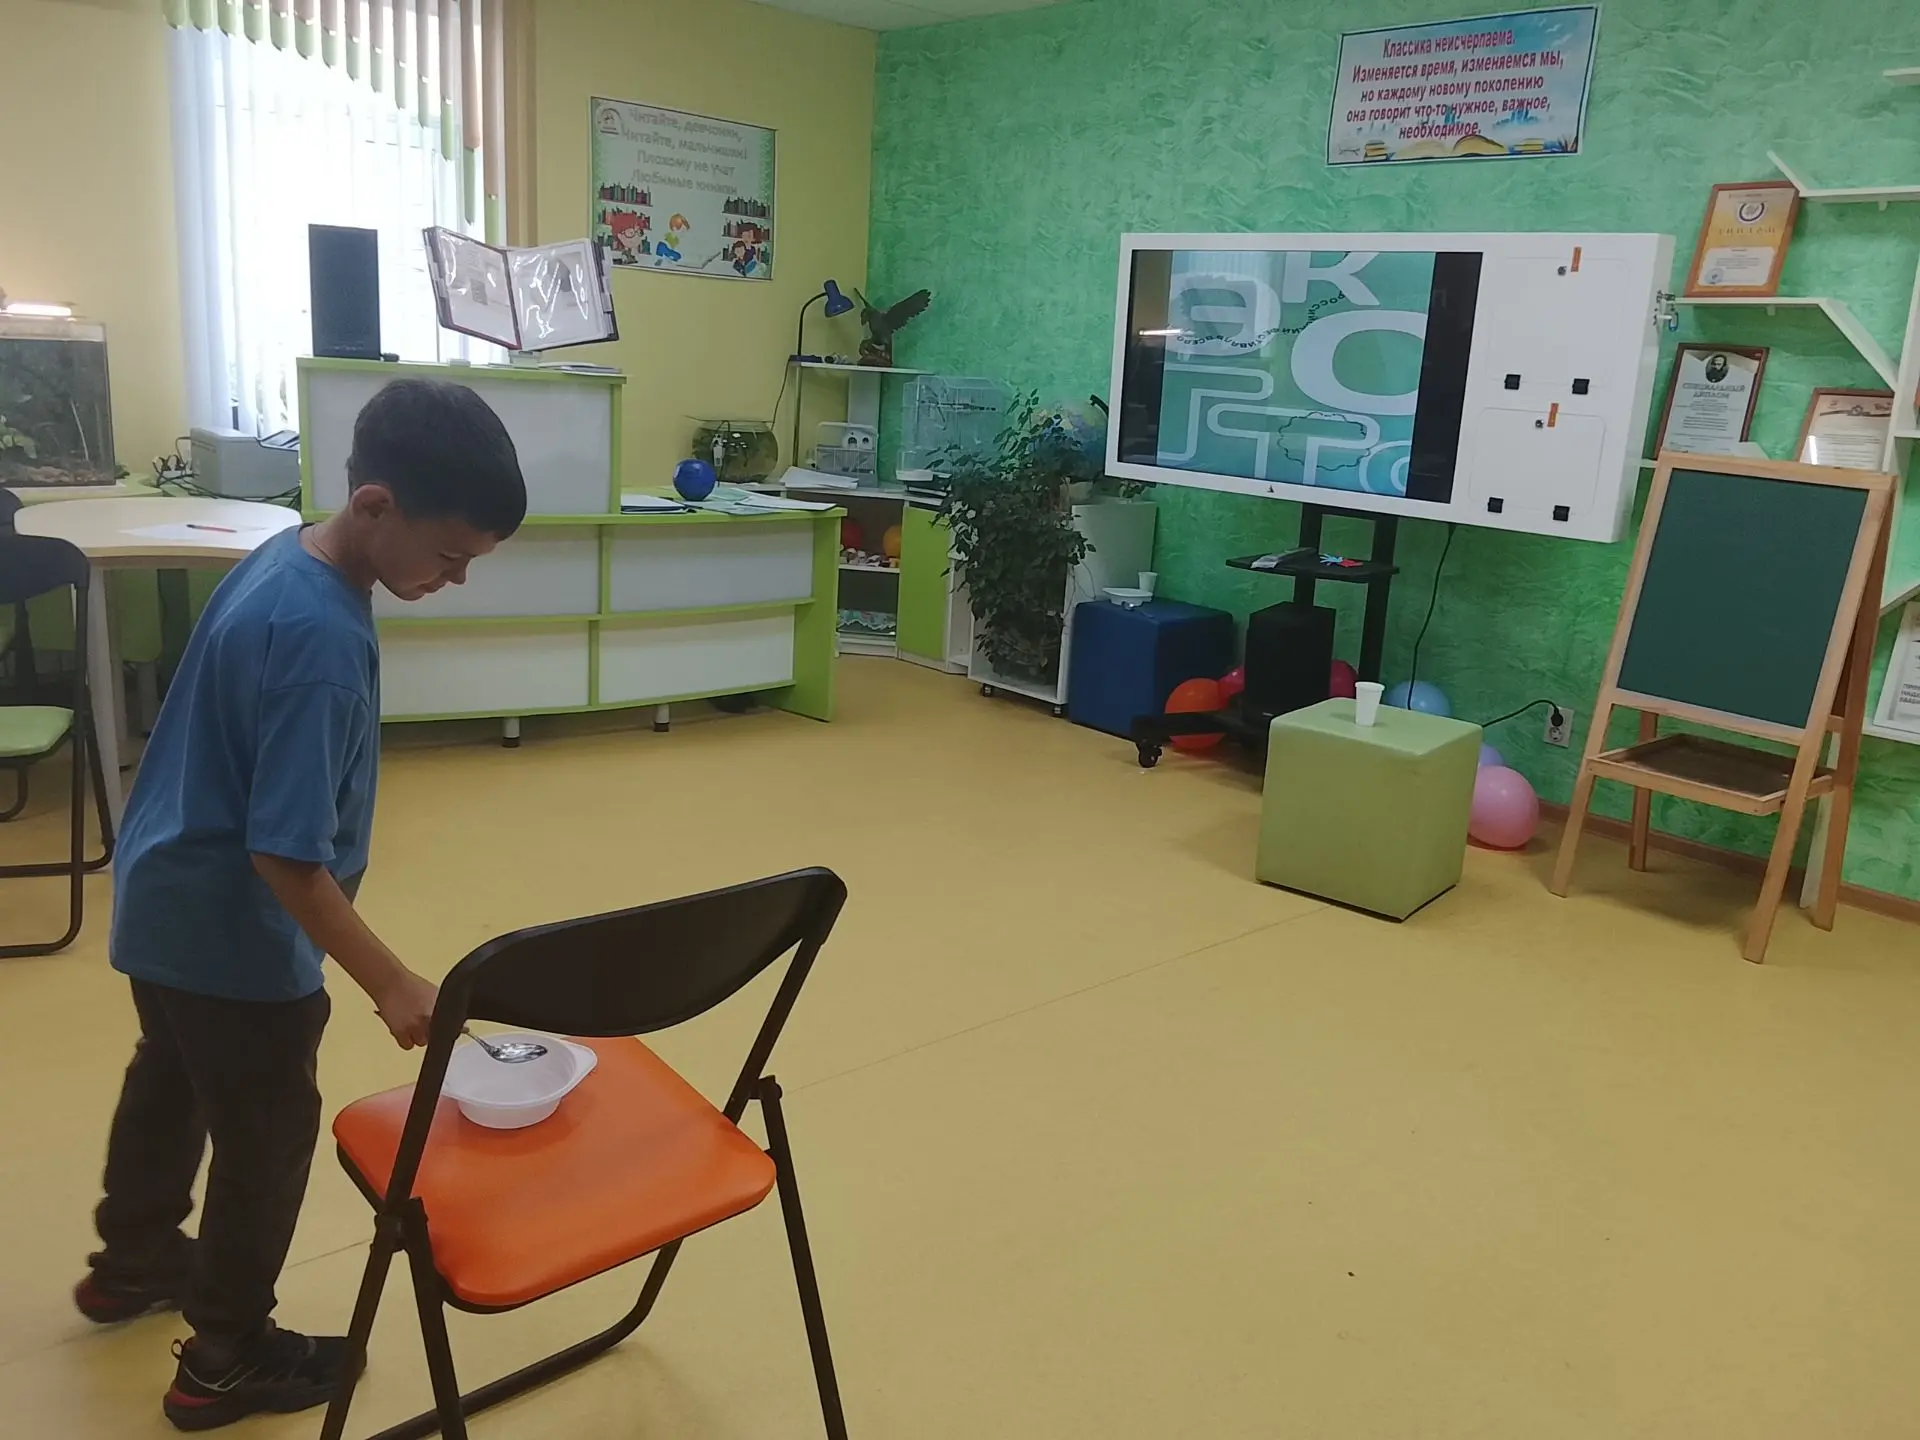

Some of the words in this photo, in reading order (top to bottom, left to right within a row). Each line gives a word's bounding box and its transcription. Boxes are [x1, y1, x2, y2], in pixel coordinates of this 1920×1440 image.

[1383, 39, 1431, 58] Классика
[1435, 30, 1515, 53] неисчерпаема.
[1352, 64, 1418, 83] Изменяется
[1421, 60, 1457, 80] время,
[1461, 52, 1536, 73] изменяемся
[1540, 50, 1563, 70] мы,
[1361, 91, 1374, 102] но
[1377, 85, 1427, 103] каждому
[1429, 81, 1471, 98] новому
[1474, 75, 1544, 94] поколению
[628, 107, 682, 132] Читайте,
[1346, 109, 1366, 122] она
[1369, 106, 1411, 123] говорит
[1415, 103, 1448, 117] что-то
[1451, 100, 1498, 119] нужное,
[1502, 95, 1550, 112] важное,
[621, 122, 675, 149] Читайте,
[1399, 121, 1481, 140] необходимое.
[637, 149, 692, 172] Плохому
[694, 160, 709, 172] не
